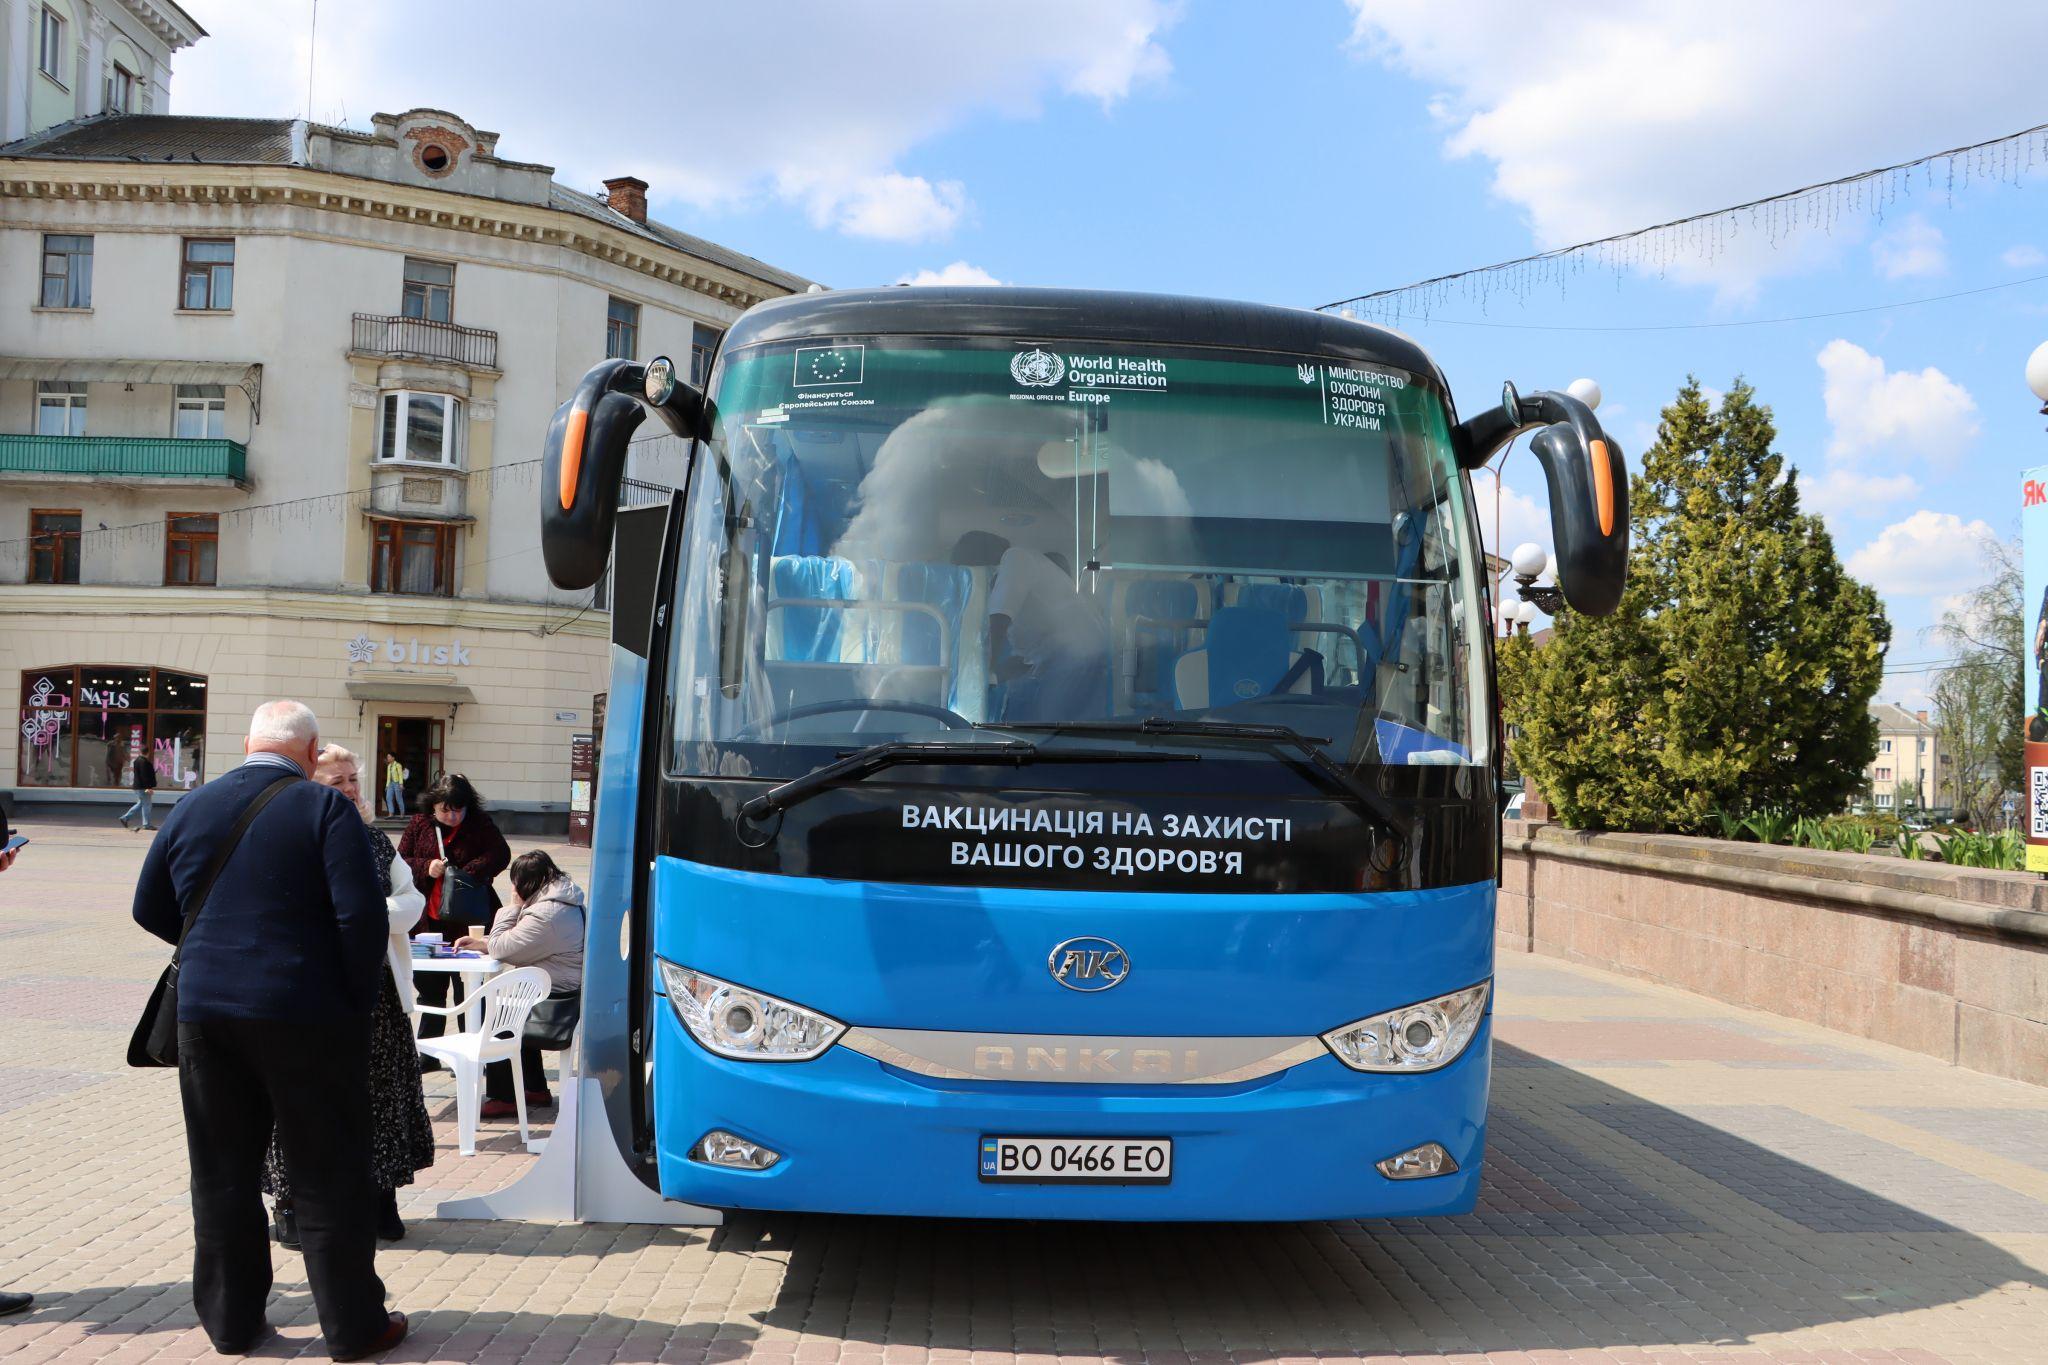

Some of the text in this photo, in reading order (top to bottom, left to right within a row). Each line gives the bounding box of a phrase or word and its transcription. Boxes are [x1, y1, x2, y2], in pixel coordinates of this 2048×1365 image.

[1069, 356, 1167, 373] World Health
[1069, 370, 1168, 387] Organization
[1328, 366, 1404, 389] МІНІСТЕРСТВО
[797, 391, 854, 400] Фінансується
[1069, 390, 1111, 405] Europe
[1330, 381, 1381, 400] ОХОРОНИ
[779, 398, 875, 410] Європейським Союзом
[1331, 397, 1386, 417] ЗДОРОВ'Я
[1332, 412, 1381, 431] УКРАЇНИ
[386, 636, 470, 666] blisk
[902, 804, 1291, 842] ВАКЦИНАЦІЯ НА ЗАХИСТІ
[951, 841, 1243, 876] ВАШОГО ЗДОРОВ'Я
[975, 1045, 1199, 1073] ANKAI
[983, 1144, 1165, 1172] UA BO 0466 EO
